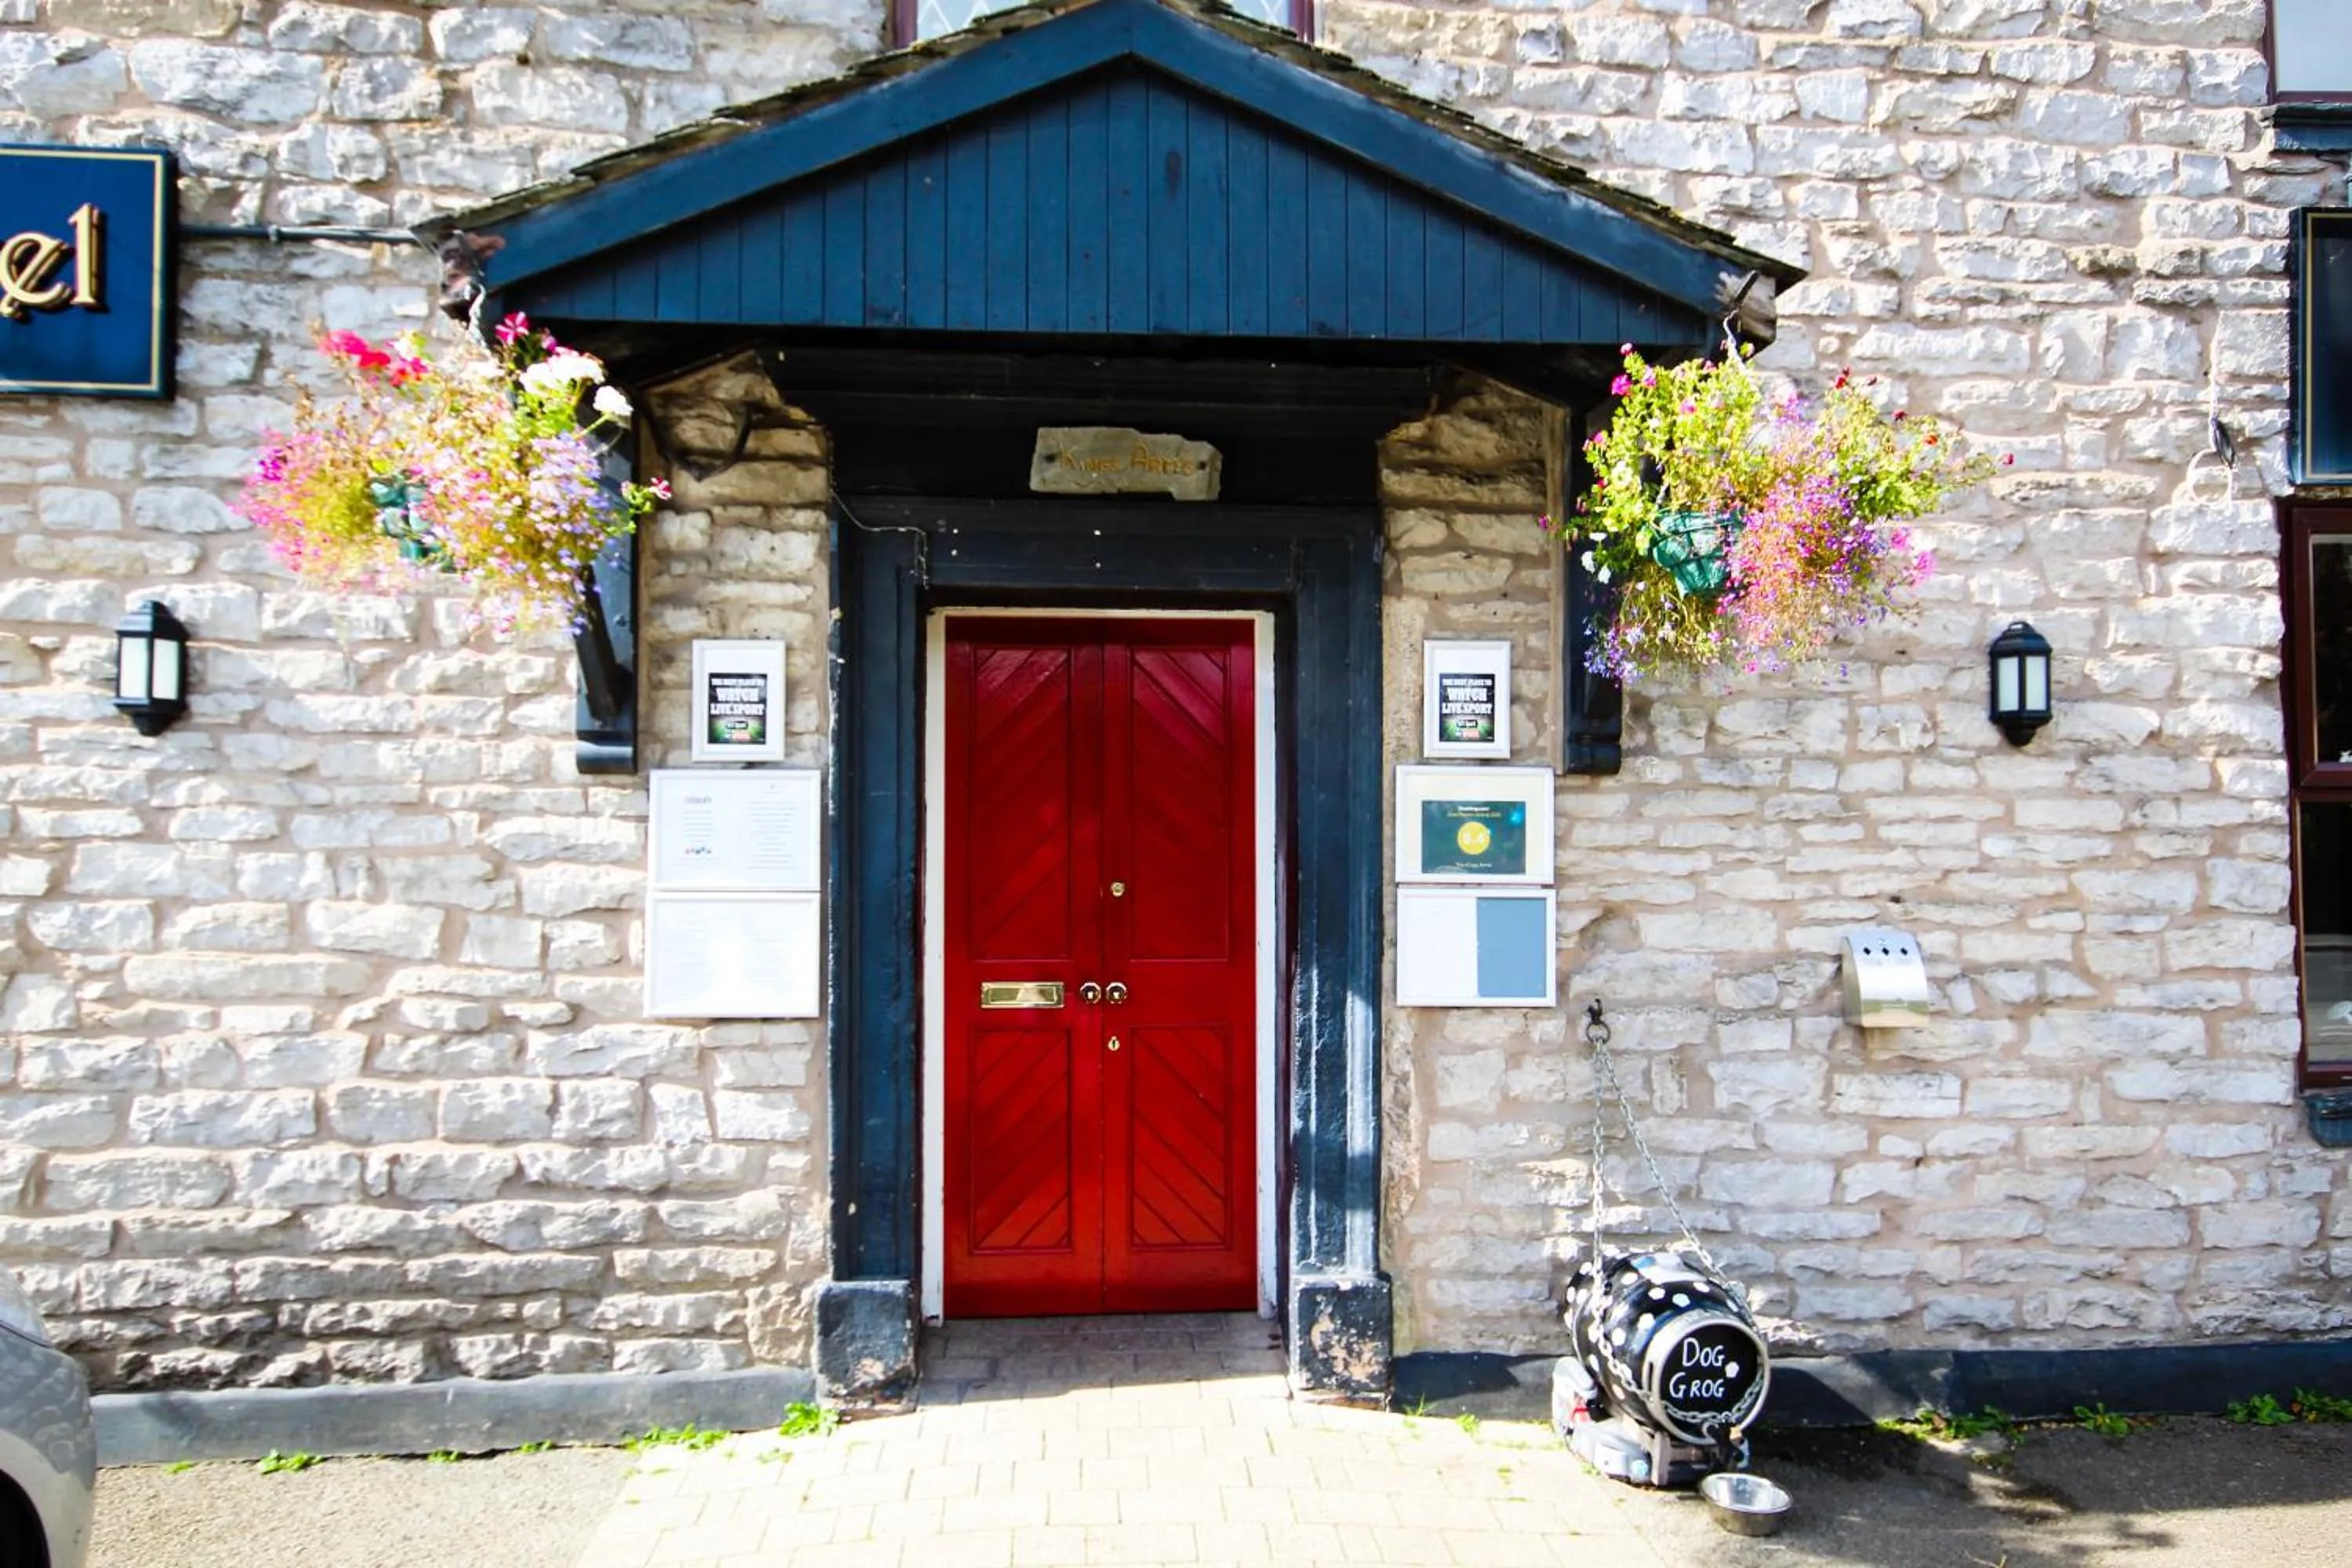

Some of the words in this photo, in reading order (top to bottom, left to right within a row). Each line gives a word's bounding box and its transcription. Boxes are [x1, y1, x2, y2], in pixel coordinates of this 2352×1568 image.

[1447, 688, 1487, 702] WATCH
[1464, 703, 1493, 714] SPORT
[1682, 1337, 1726, 1367] DOG
[1669, 1371, 1726, 1399] GROG
